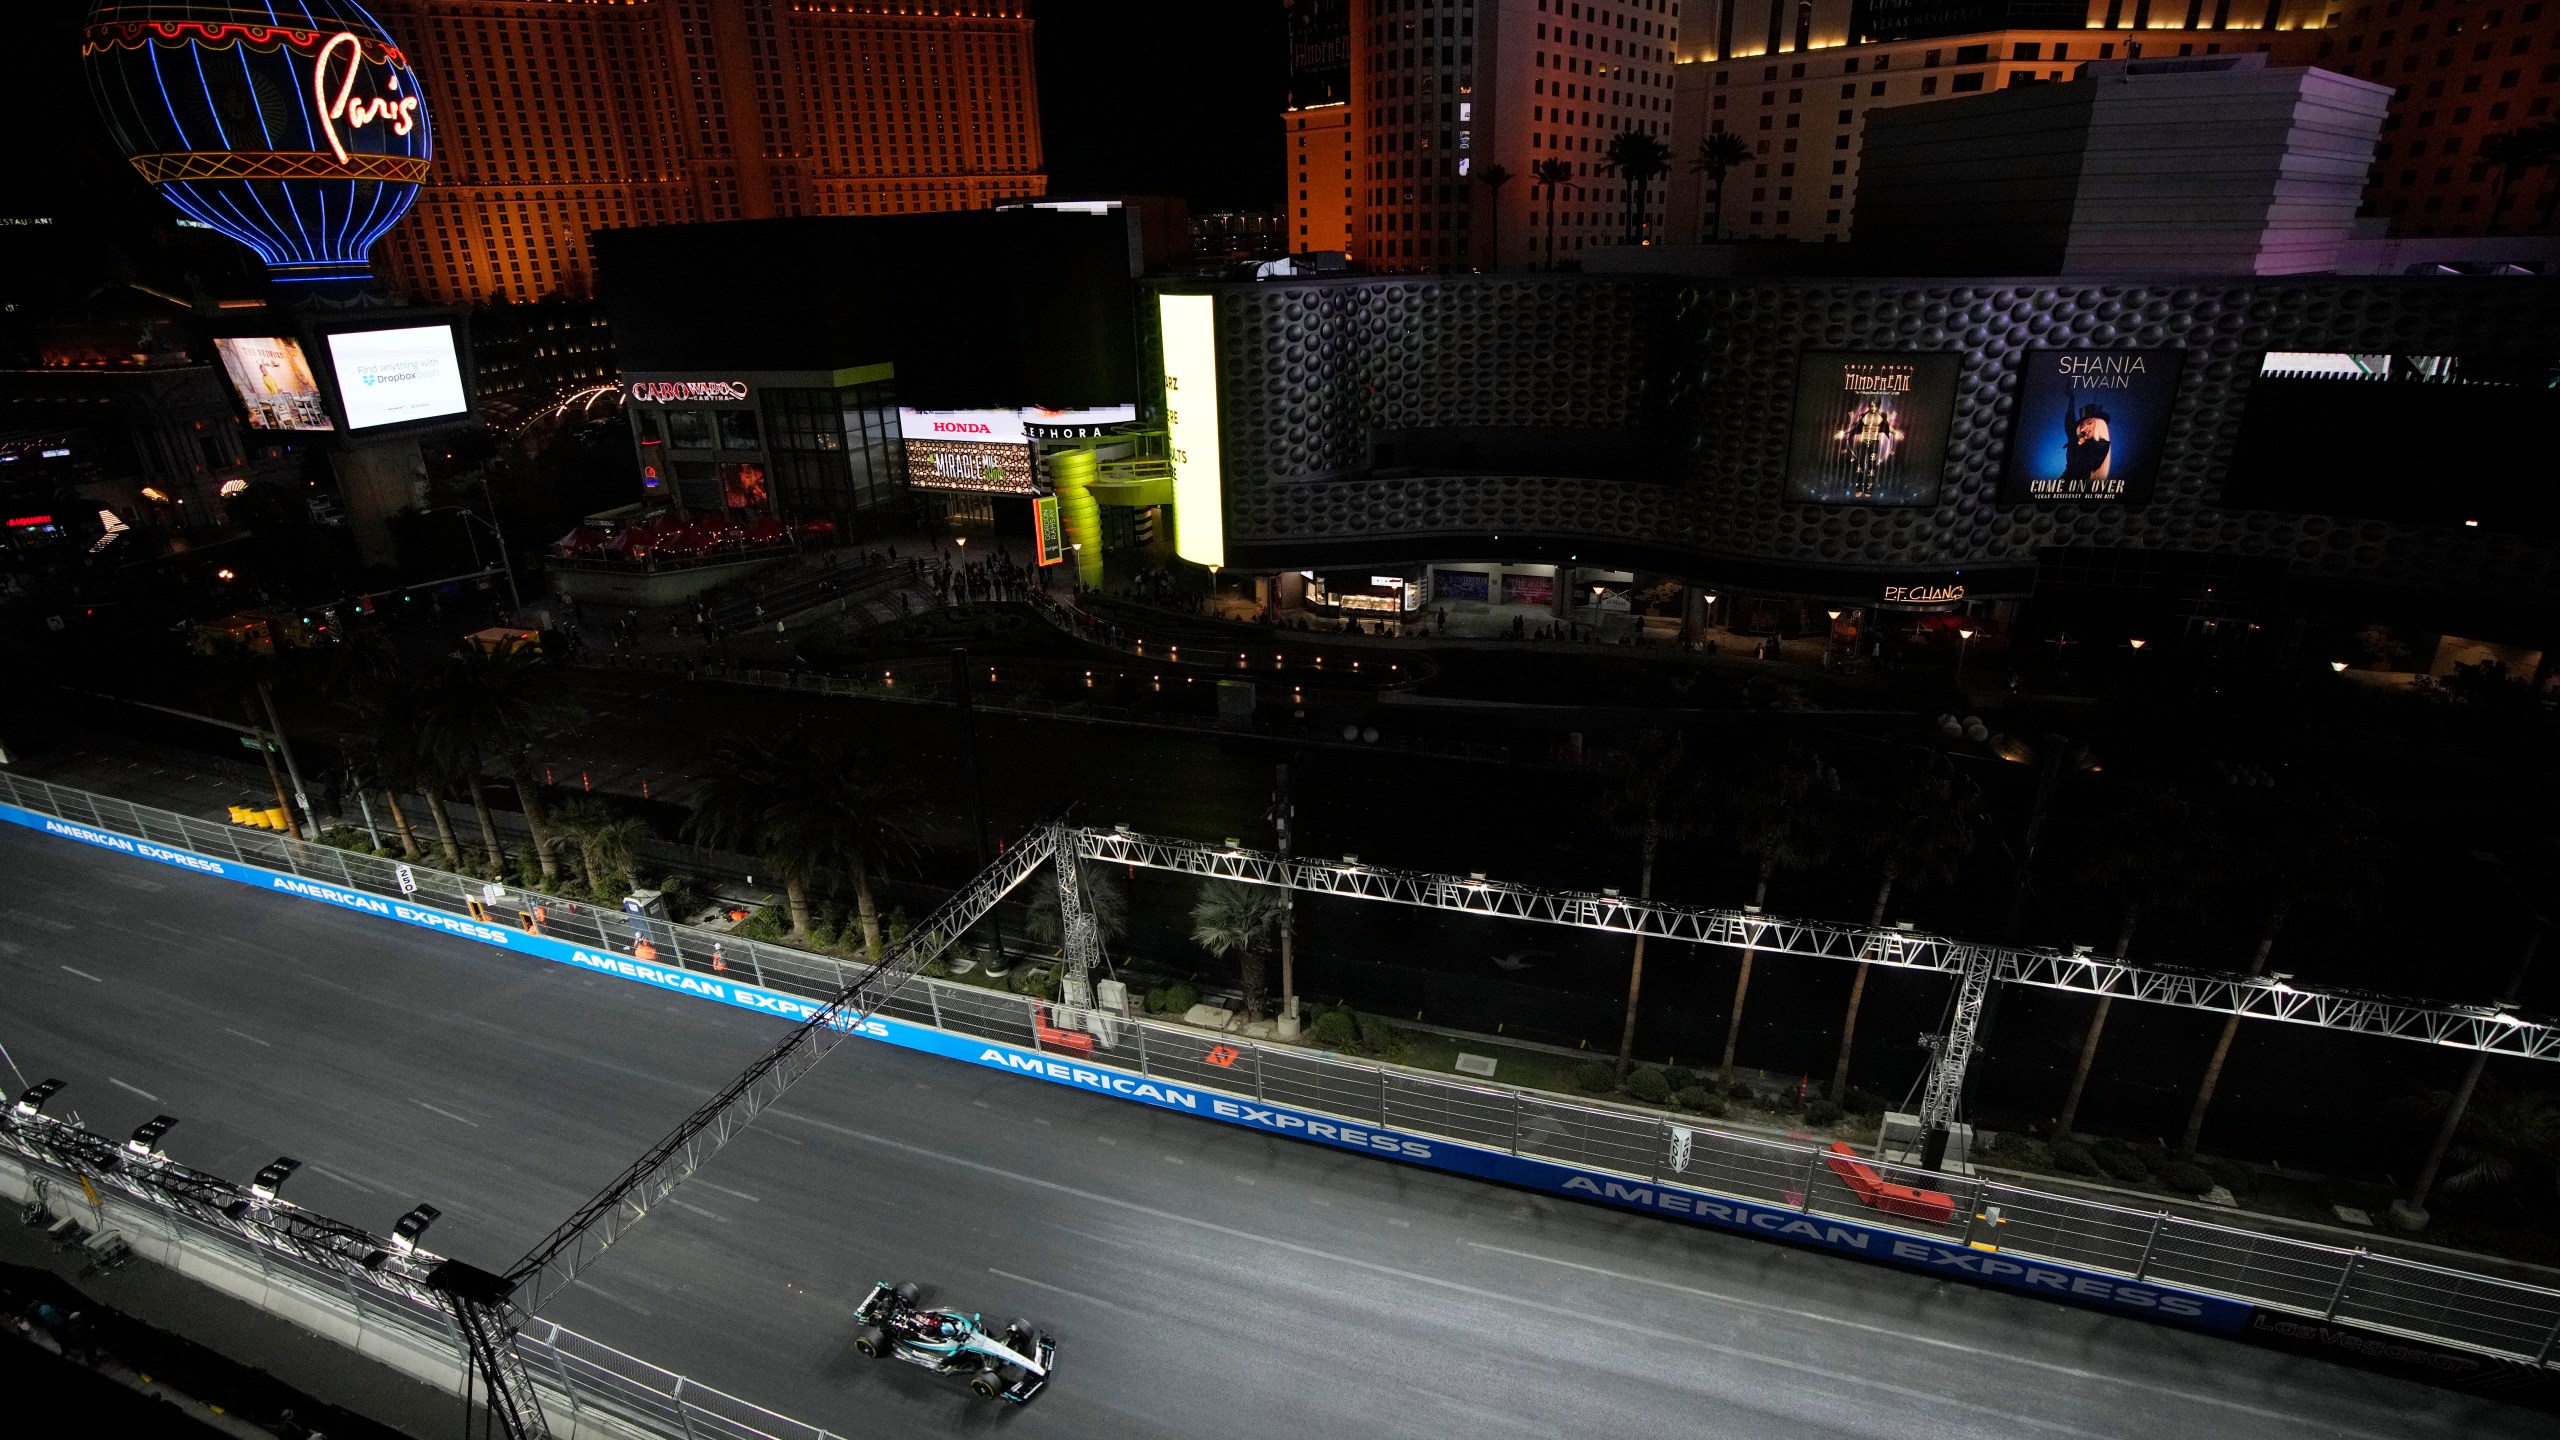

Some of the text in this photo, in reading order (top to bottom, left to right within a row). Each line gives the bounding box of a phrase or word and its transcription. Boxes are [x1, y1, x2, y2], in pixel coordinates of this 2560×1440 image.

[314, 31, 418, 165] Paris
[357, 359, 439, 375] Find anything with
[2058, 356, 2146, 374] SHANIA
[377, 372, 417, 384] Dropbox
[1844, 373, 1911, 391] MINDFREAK
[2071, 375, 2130, 389] TWAIN
[632, 381, 740, 405] CABO WABO
[933, 422, 992, 434] HONDA
[935, 453, 1000, 480] MIRACLE MILE
[984, 468, 1007, 481] SHOPS
[2030, 479, 2126, 493] COME ON OVER
[1042, 509, 1051, 541] GORDON
[1049, 509, 1057, 540] RAMSAY
[46, 820, 225, 874] AMERICAN EXPRESS
[400, 869, 413, 892] 250
[273, 877, 508, 944] AMERICAN EXPRESS
[571, 950, 725, 998] AMERICAN
[979, 1048, 1432, 1159] AMERICAN EXPRESS
[1671, 1134, 1680, 1167] 200
[1561, 1175, 2205, 1317] AMERICAN EXPRESS
